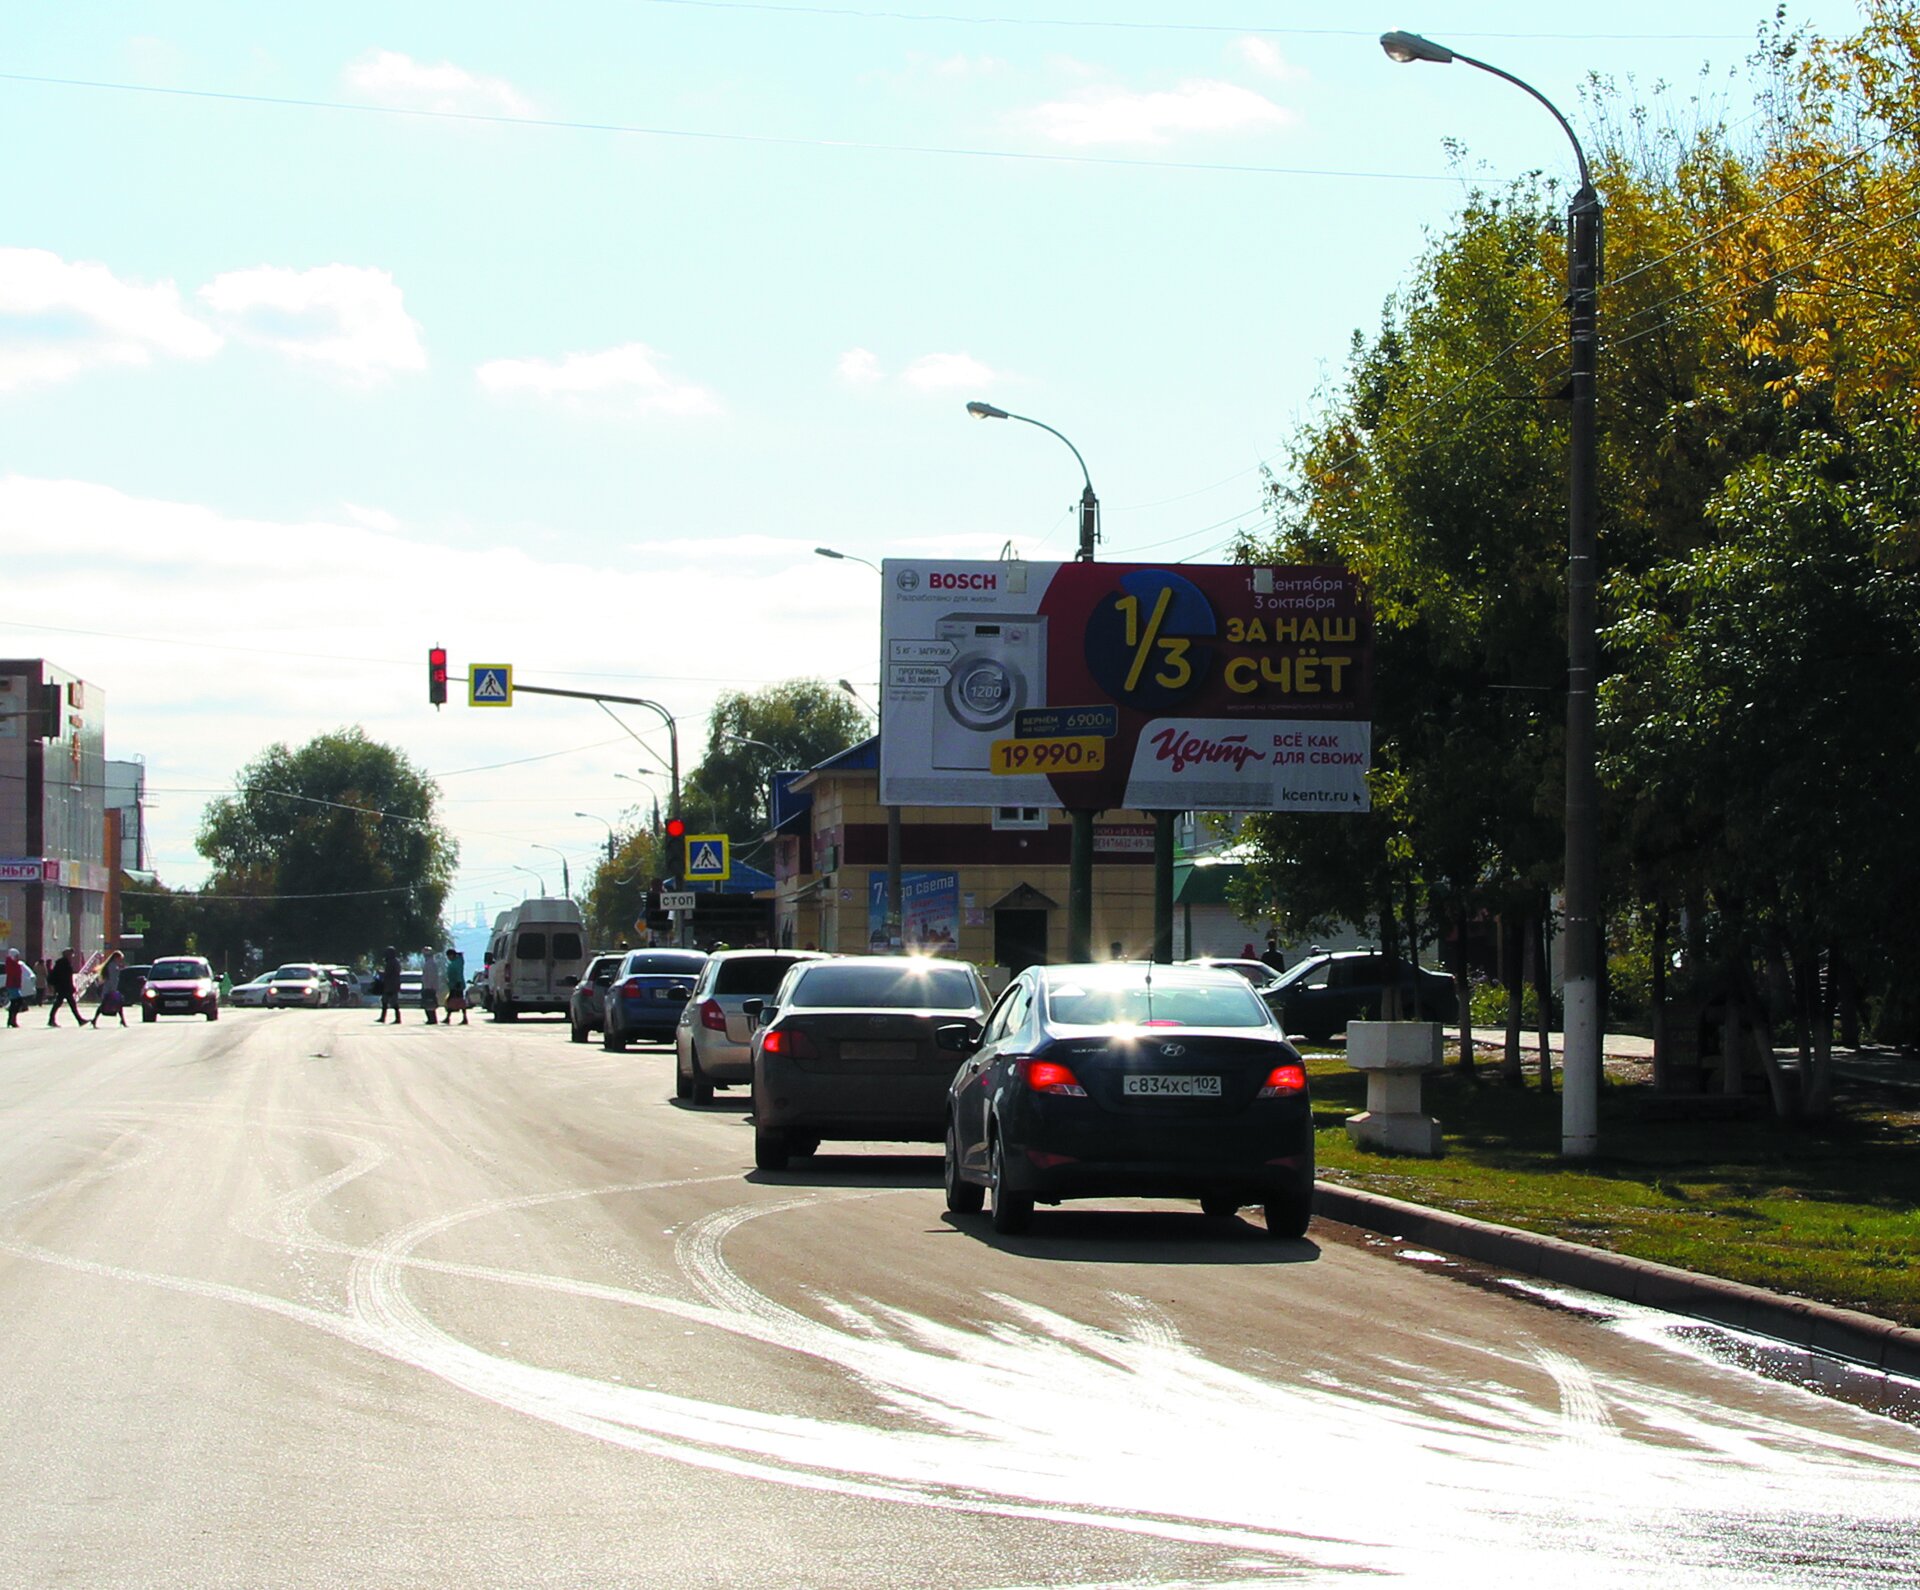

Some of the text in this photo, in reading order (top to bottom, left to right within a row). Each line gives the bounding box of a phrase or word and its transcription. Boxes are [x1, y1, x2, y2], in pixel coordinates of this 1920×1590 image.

[929, 573, 997, 590] BOSCH
[1271, 576, 1343, 593] ентября
[953, 594, 968, 603] для
[1254, 594, 1336, 612] 3 октября
[1226, 616, 1357, 642] ЗА НАШ
[1115, 586, 1192, 692] 1/3
[919, 647, 951, 655] ЗАГРУЗКА
[898, 667, 940, 675] ПРОГРАММА
[1223, 649, 1352, 694] СЧЁТ
[971, 686, 1002, 699] 1200
[1272, 732, 1339, 748] ВСЁ КАК
[1150, 727, 1267, 772] Центр
[1272, 751, 1364, 766] ДЛЯ СВОИХ
[1282, 787, 1349, 802] kcentr.ru
[0, 866, 36, 877] ньги
[873, 881, 883, 905] 7
[916, 876, 954, 894] света
[662, 896, 694, 906] СТОП
[1128, 1077, 1218, 1093] С834ХС 102
